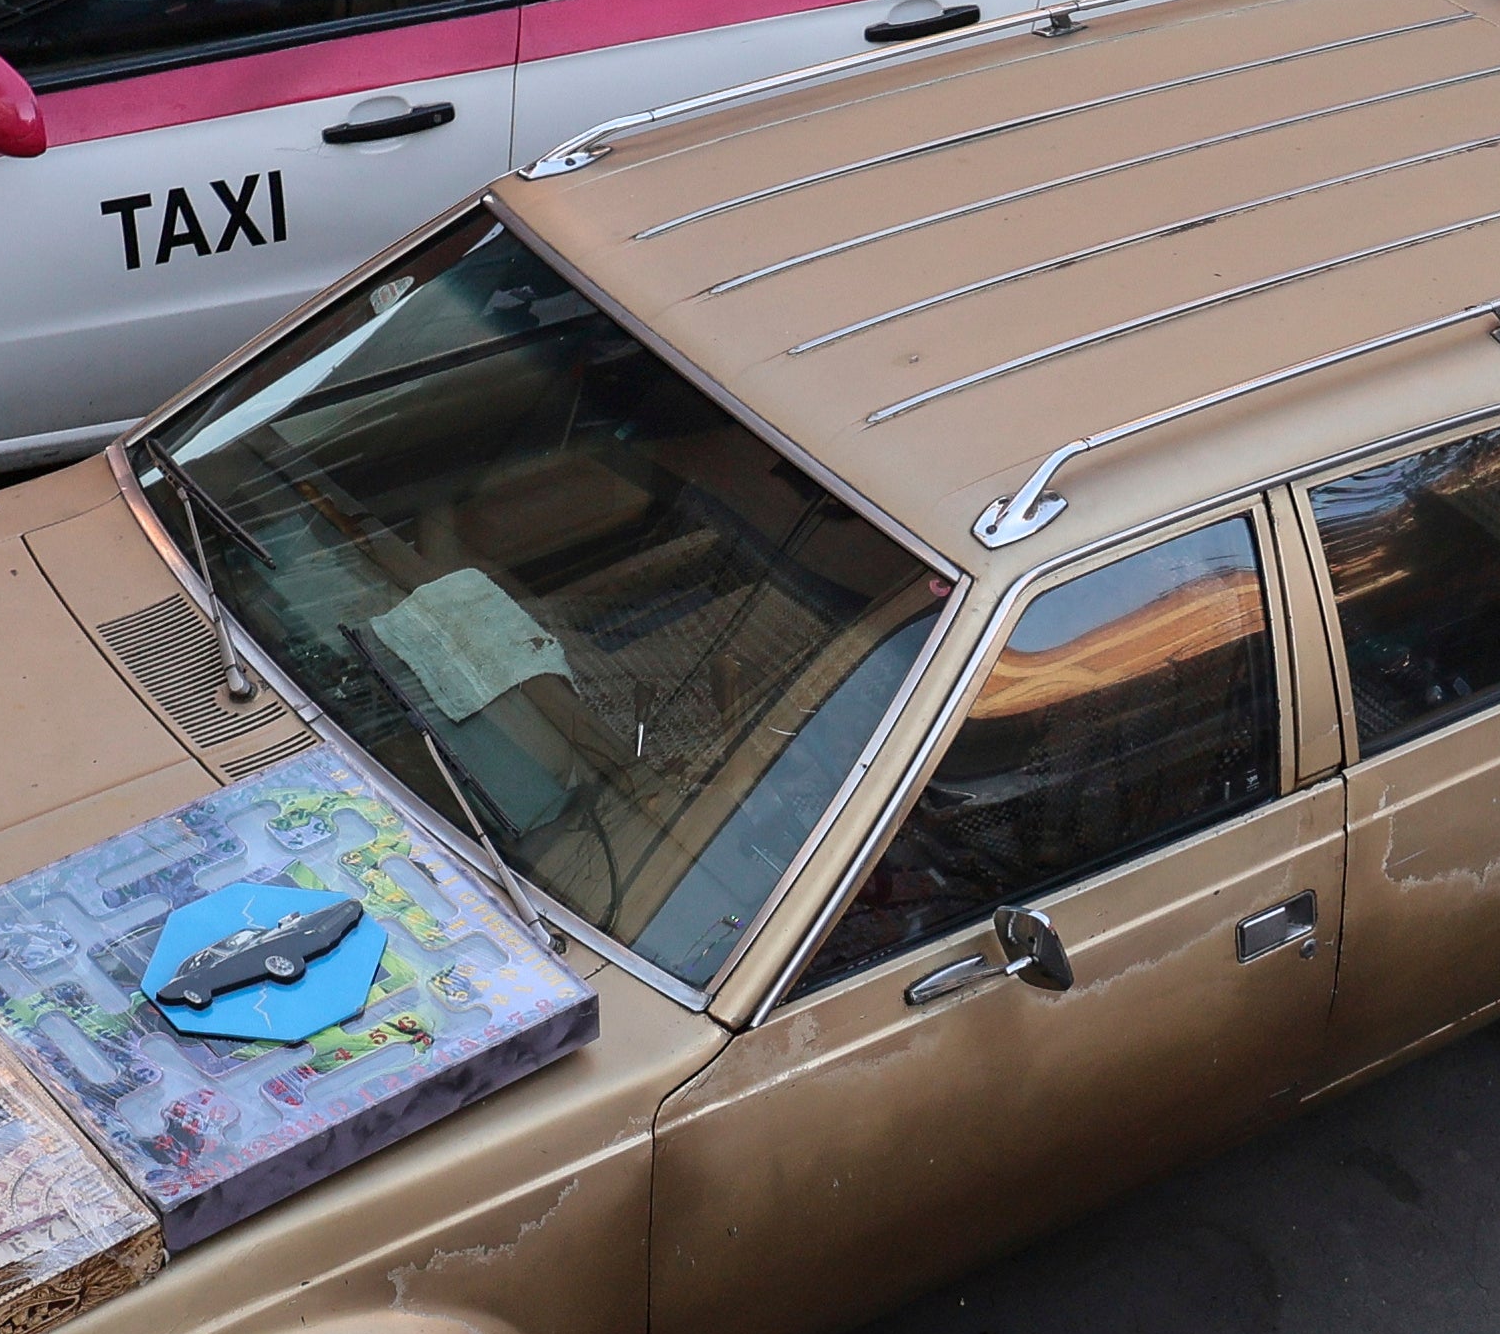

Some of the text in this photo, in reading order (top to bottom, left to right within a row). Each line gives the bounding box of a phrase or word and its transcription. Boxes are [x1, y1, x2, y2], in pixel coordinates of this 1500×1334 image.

[100, 170, 286, 271] TAXI
[367, 1028, 388, 1045] 5
[397, 1016, 417, 1030] 6
